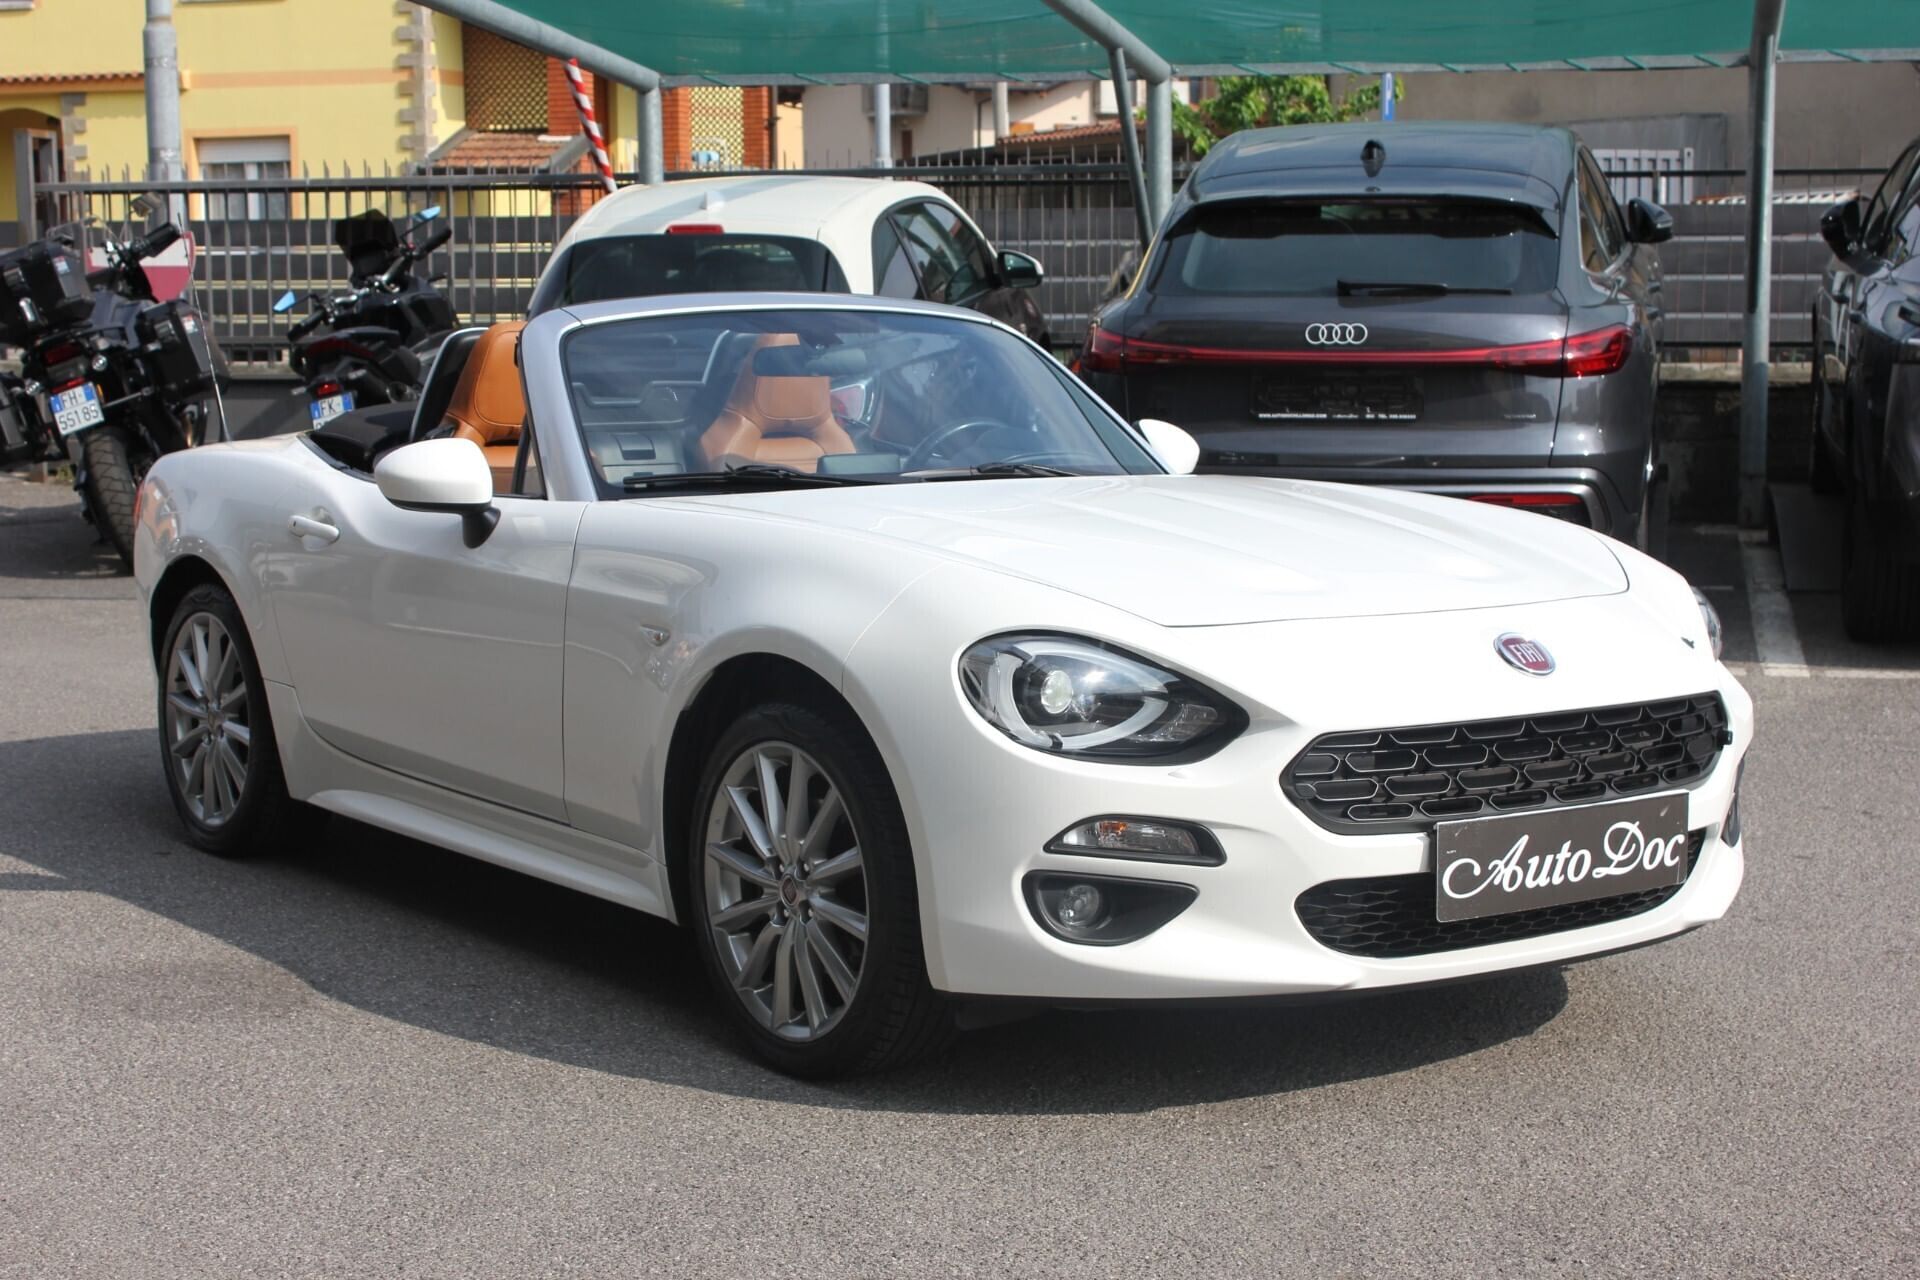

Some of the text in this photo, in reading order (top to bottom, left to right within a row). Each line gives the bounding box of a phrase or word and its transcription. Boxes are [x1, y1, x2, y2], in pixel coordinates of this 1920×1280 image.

[60, 390, 79, 409] FH
[319, 398, 338, 417] FK
[1507, 642, 1545, 664] FIAT
[1442, 821, 1686, 899] Auto Doc
